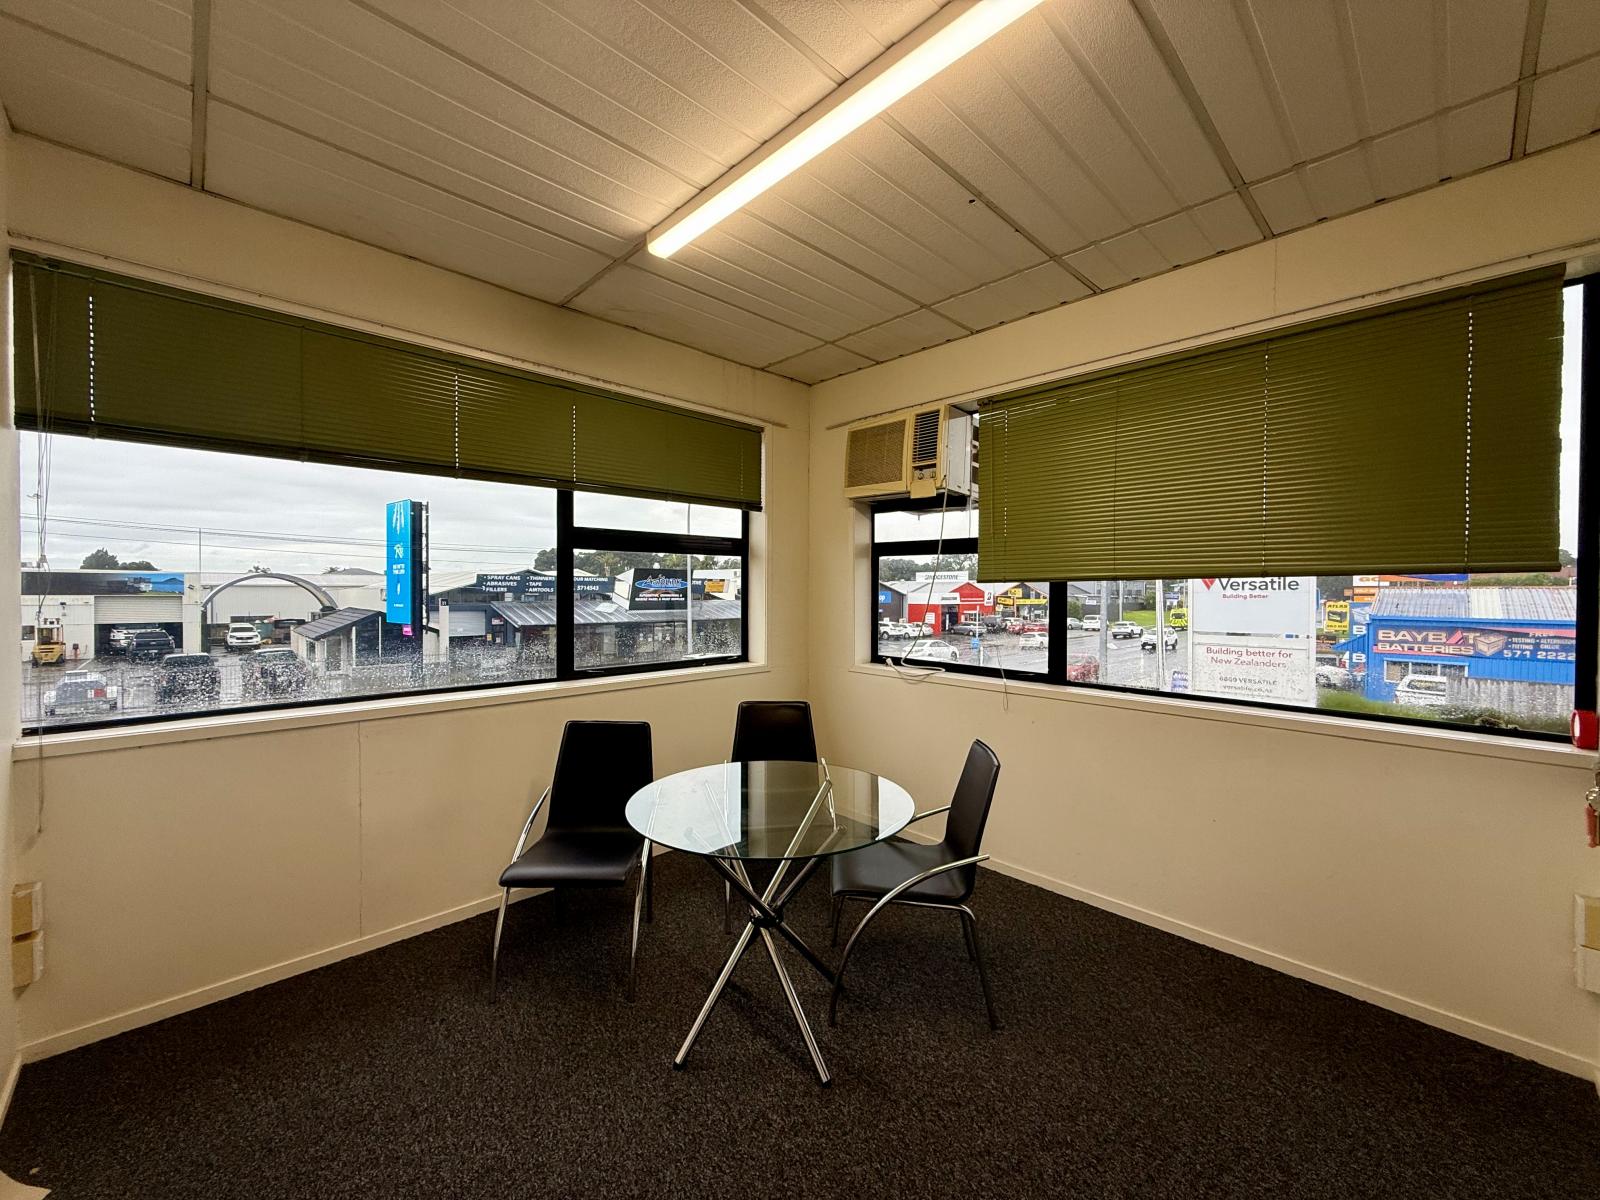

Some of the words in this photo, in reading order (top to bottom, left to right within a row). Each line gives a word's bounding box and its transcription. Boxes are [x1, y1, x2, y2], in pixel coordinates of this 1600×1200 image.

[1218, 577, 1300, 591] Versatile
[1377, 629, 1480, 645] BAYBAT
[1206, 646, 1243, 657] Building
[1245, 648, 1276, 658] better
[1278, 649, 1293, 659] for
[1377, 642, 1475, 655] BATTERIES
[1503, 649, 1531, 658] 571
[1536, 650, 1576, 661] 2222
[1210, 656, 1232, 665] New
[1234, 657, 1287, 668] Zealanders
[1238, 677, 1278, 686] VERSATILE
